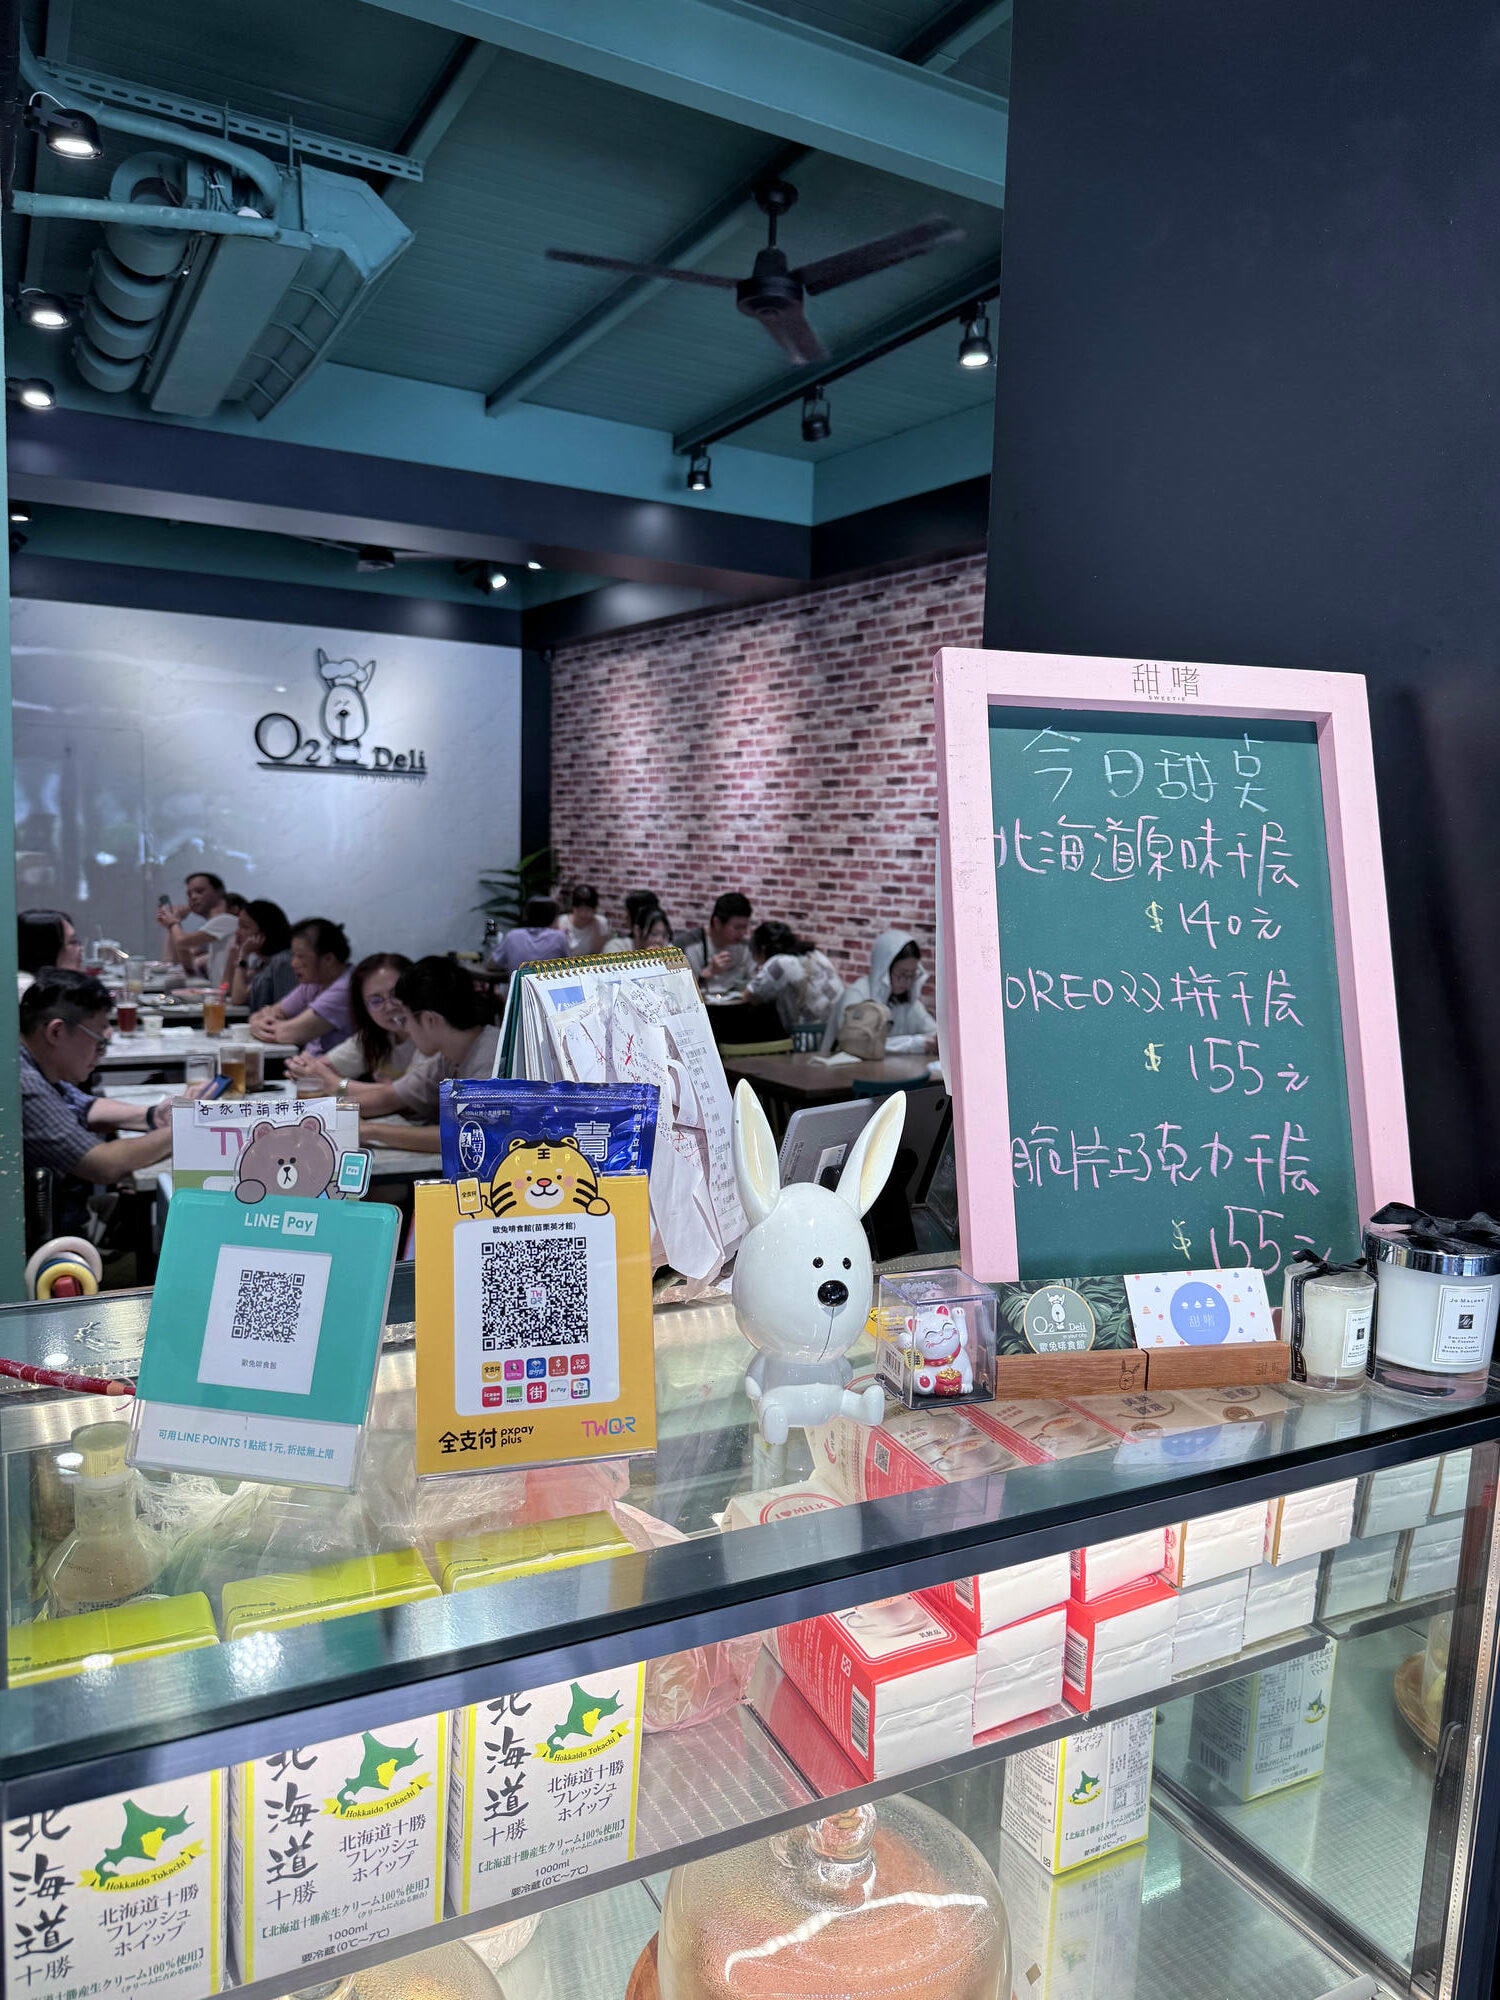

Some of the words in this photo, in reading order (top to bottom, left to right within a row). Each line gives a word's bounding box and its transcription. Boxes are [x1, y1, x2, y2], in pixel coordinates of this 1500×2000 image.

[1132, 664, 1200, 697] 甜嗜
[372, 746, 427, 770] Deli
[244, 1212, 280, 1229] LINE
[287, 1216, 313, 1232] Pay
[1069, 1322, 1086, 1331] Deli
[202, 1433, 240, 1449] POINTS
[438, 1428, 497, 1454] 全支付
[500, 1425, 534, 1438] pxpay
[500, 1435, 522, 1447] plus
[581, 1416, 636, 1438] TWQR
[793, 1502, 828, 1516] MILK
[553, 1750, 587, 1762] Hokkaido
[588, 1736, 616, 1755] Tokachi
[547, 1759, 625, 1794] 北海道十勝
[345, 1805, 384, 1819] Hokkaido
[384, 1789, 416, 1811] Tokachi
[553, 1781, 618, 1809] フレッシュ
[557, 1792, 614, 1822] ホイップ
[339, 1813, 427, 1853] 北海道十勝
[482, 1818, 529, 1848] 十勝
[346, 1837, 420, 1869] フレッシュ
[352, 1850, 416, 1883] ホイップ
[534, 1858, 570, 1877] 1000ml
[105, 1877, 150, 1891] Hokkaido
[151, 1860, 187, 1882] Tokachi
[99, 1884, 199, 1928] 北海道十勝
[267, 1879, 320, 1912] 十勝
[107, 1909, 192, 1943] フレッシュ
[114, 1920, 187, 1957] ホイップ
[328, 1923, 368, 1943] 1000ml
[14, 1954, 76, 1987] 十勝
